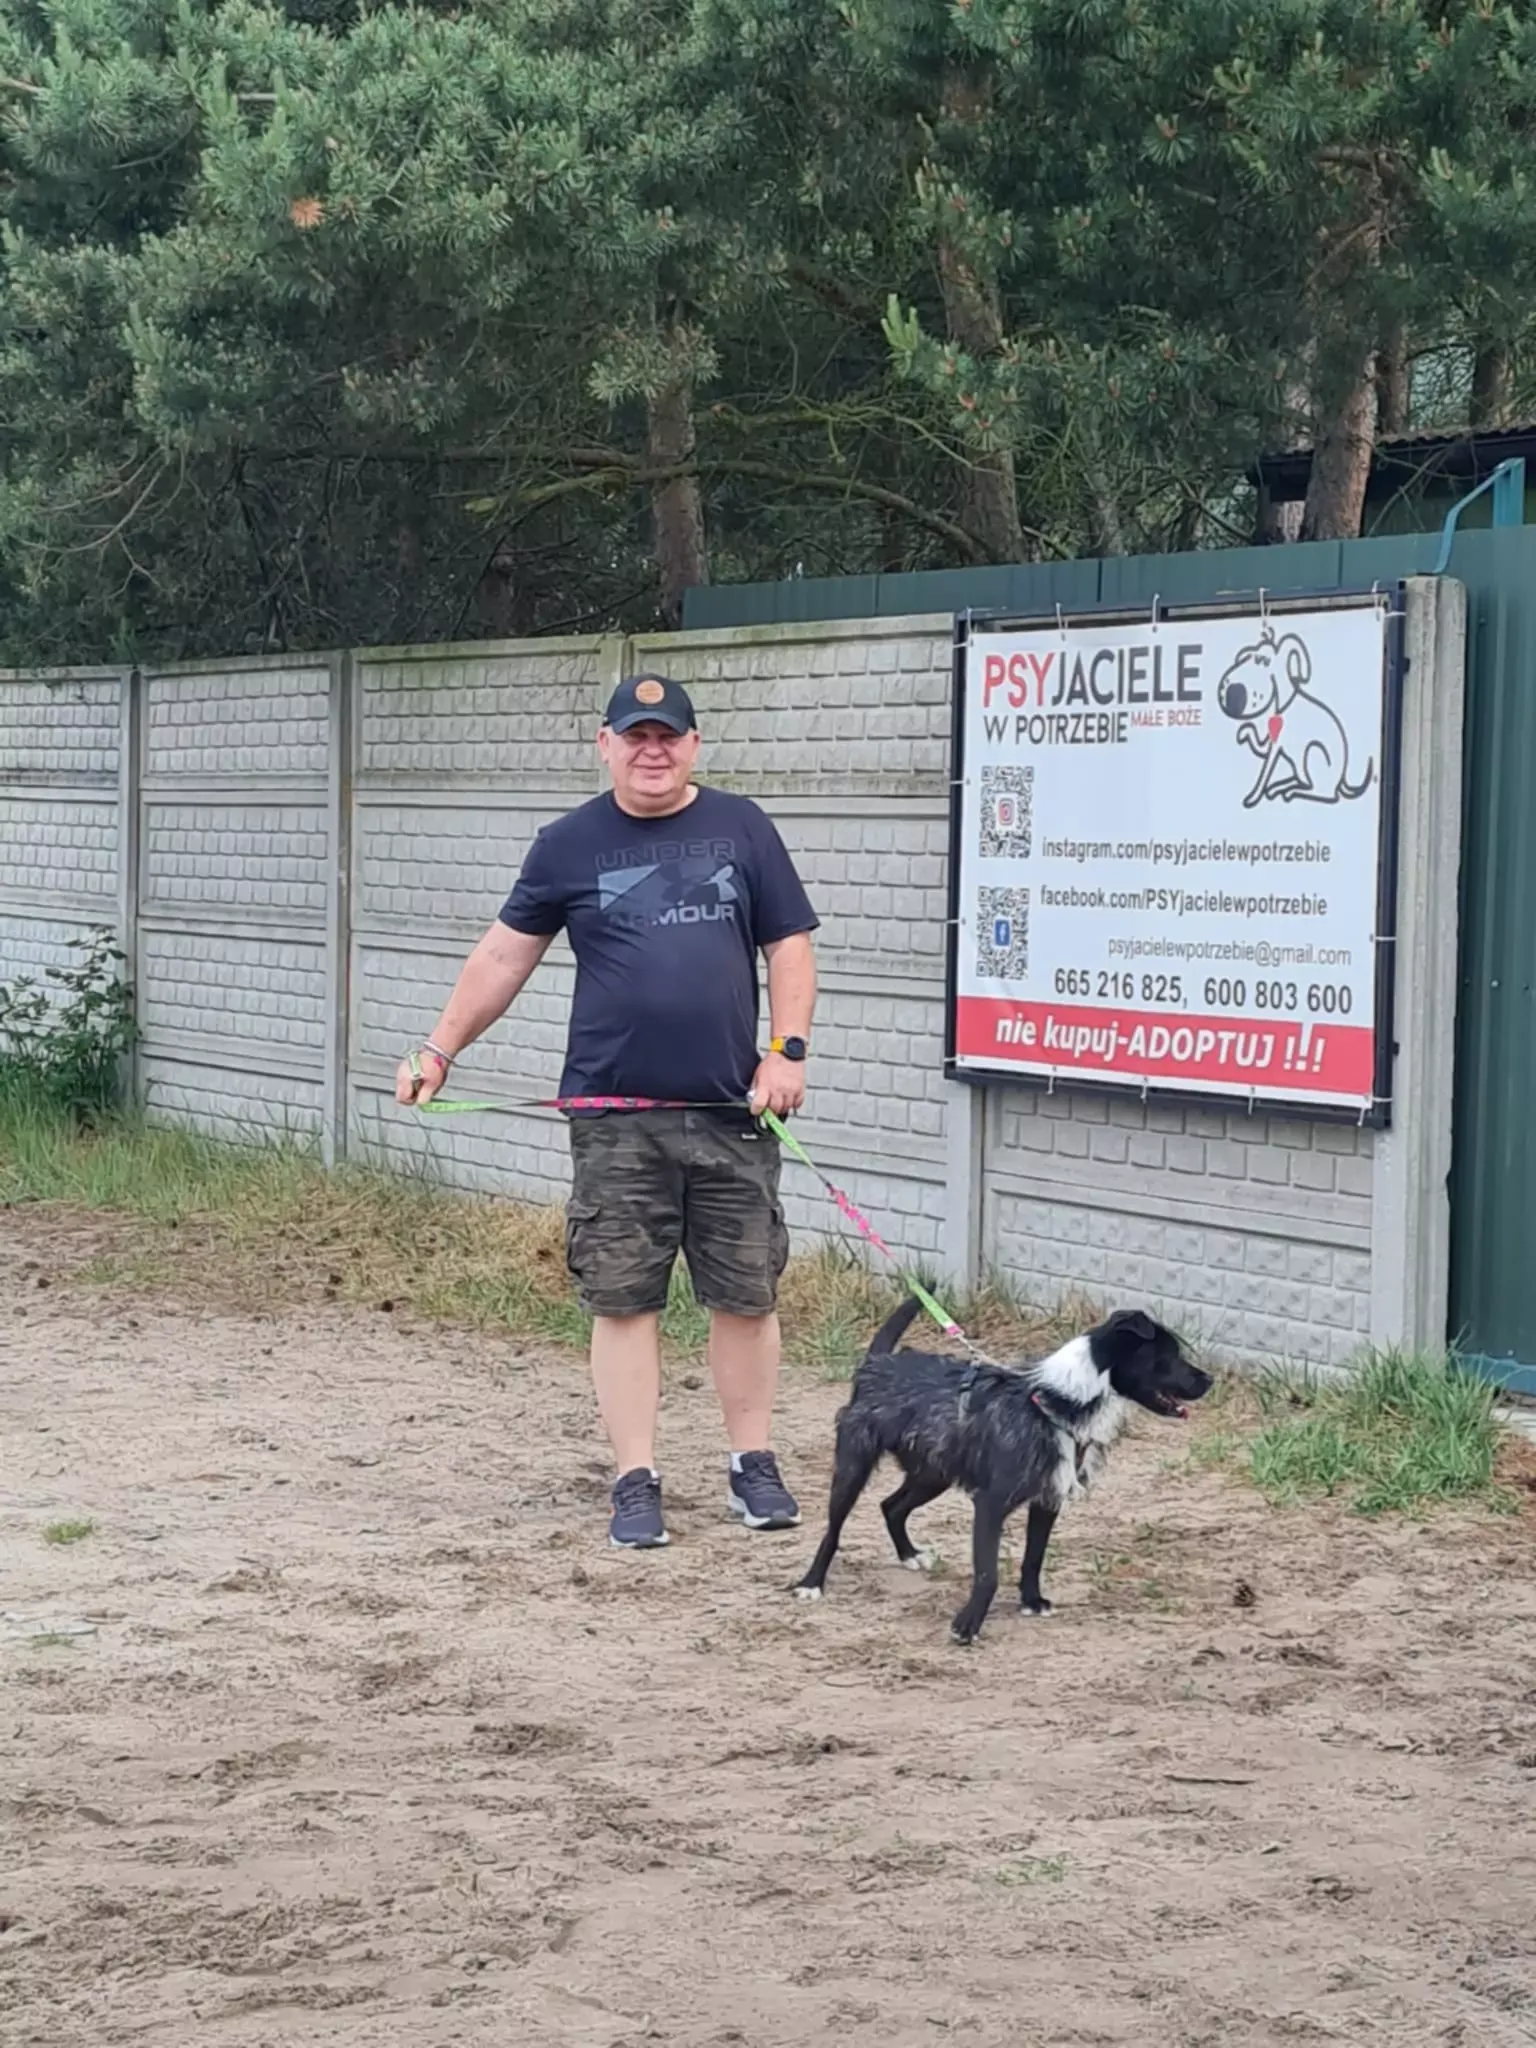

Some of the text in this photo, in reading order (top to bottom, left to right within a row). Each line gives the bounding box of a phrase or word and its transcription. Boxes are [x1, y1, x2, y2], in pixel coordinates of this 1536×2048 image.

[983, 643, 1203, 708] PSYJACIELE
[983, 711, 1128, 744] W POTRZEBIE
[1131, 705, 1203, 727] MAŁE BOŻE
[595, 838, 736, 872] UNDER
[1042, 838, 1332, 866] instagram.com/psyjacielewpotrzebie
[1040, 884, 1328, 917] facebook.com/PSYjacielewpotrzebie
[1108, 937, 1353, 966] psyjacielewpotrzebie@gmail.com
[1054, 968, 1353, 1014] 665 216 825, 600 803 600
[995, 1013, 1037, 1045] nie
[1043, 1018, 1274, 1067] kupuj-ADOPTUJ
